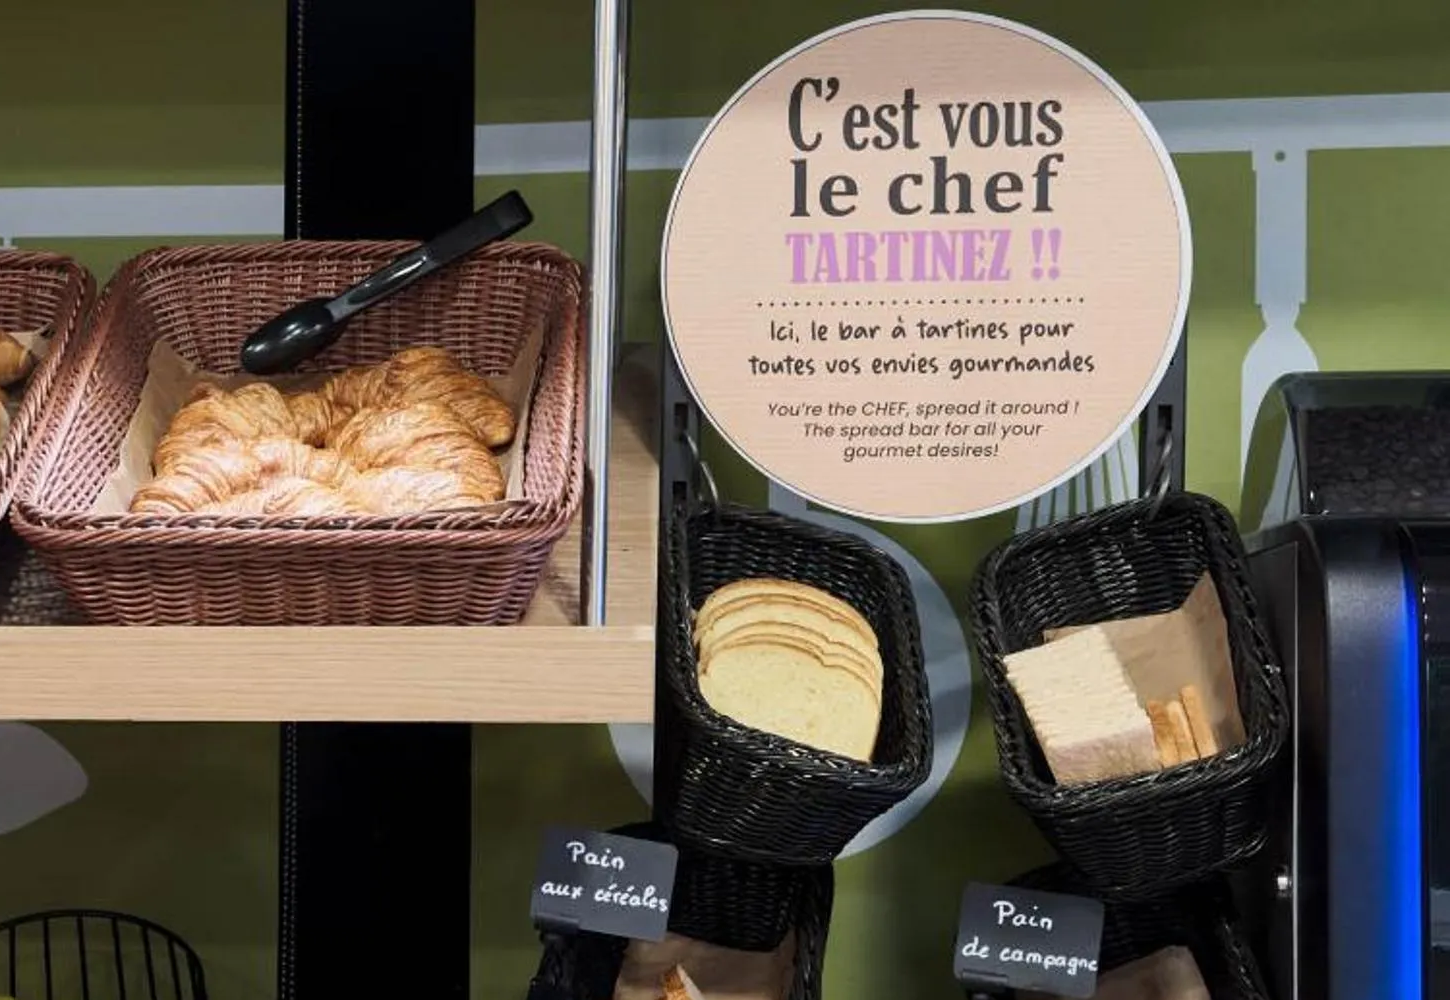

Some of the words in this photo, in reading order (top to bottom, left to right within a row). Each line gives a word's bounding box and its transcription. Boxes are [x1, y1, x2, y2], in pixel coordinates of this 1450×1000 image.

[788, 77, 921, 152] C'est
[938, 99, 1064, 149] vous
[790, 157, 860, 218] le
[887, 152, 1065, 216] chef
[784, 228, 1013, 284] TARTINEZ
[1030, 227, 1063, 282] !!
[769, 319, 800, 344] Ici,
[810, 319, 829, 342] le
[838, 319, 881, 341] bar
[890, 315, 907, 340] à
[915, 318, 1010, 341] tartines
[1019, 321, 1076, 346] pour
[747, 354, 816, 376] toutes
[825, 356, 862, 376] vos
[870, 352, 940, 375] envies
[948, 350, 1096, 380] gourmandes
[767, 401, 823, 418] You're
[828, 401, 858, 417] the
[861, 401, 911, 419] CHEF,
[915, 400, 980, 419] spread
[985, 400, 997, 417] it
[1001, 400, 1069, 416] around
[803, 423, 837, 438] The
[839, 422, 905, 440] spread
[908, 422, 940, 437] bar
[943, 422, 970, 438] for
[973, 422, 998, 437] all
[1000, 423, 1045, 441] your
[843, 443, 924, 463] gourmet
[927, 442, 1000, 459] desires!
[565, 841, 625, 871] Pain
[540, 881, 584, 899] aux
[593, 883, 669, 912] céréales
[993, 899, 1054, 931] Pain
[961, 935, 990, 958] de
[998, 947, 1099, 976] campagne
